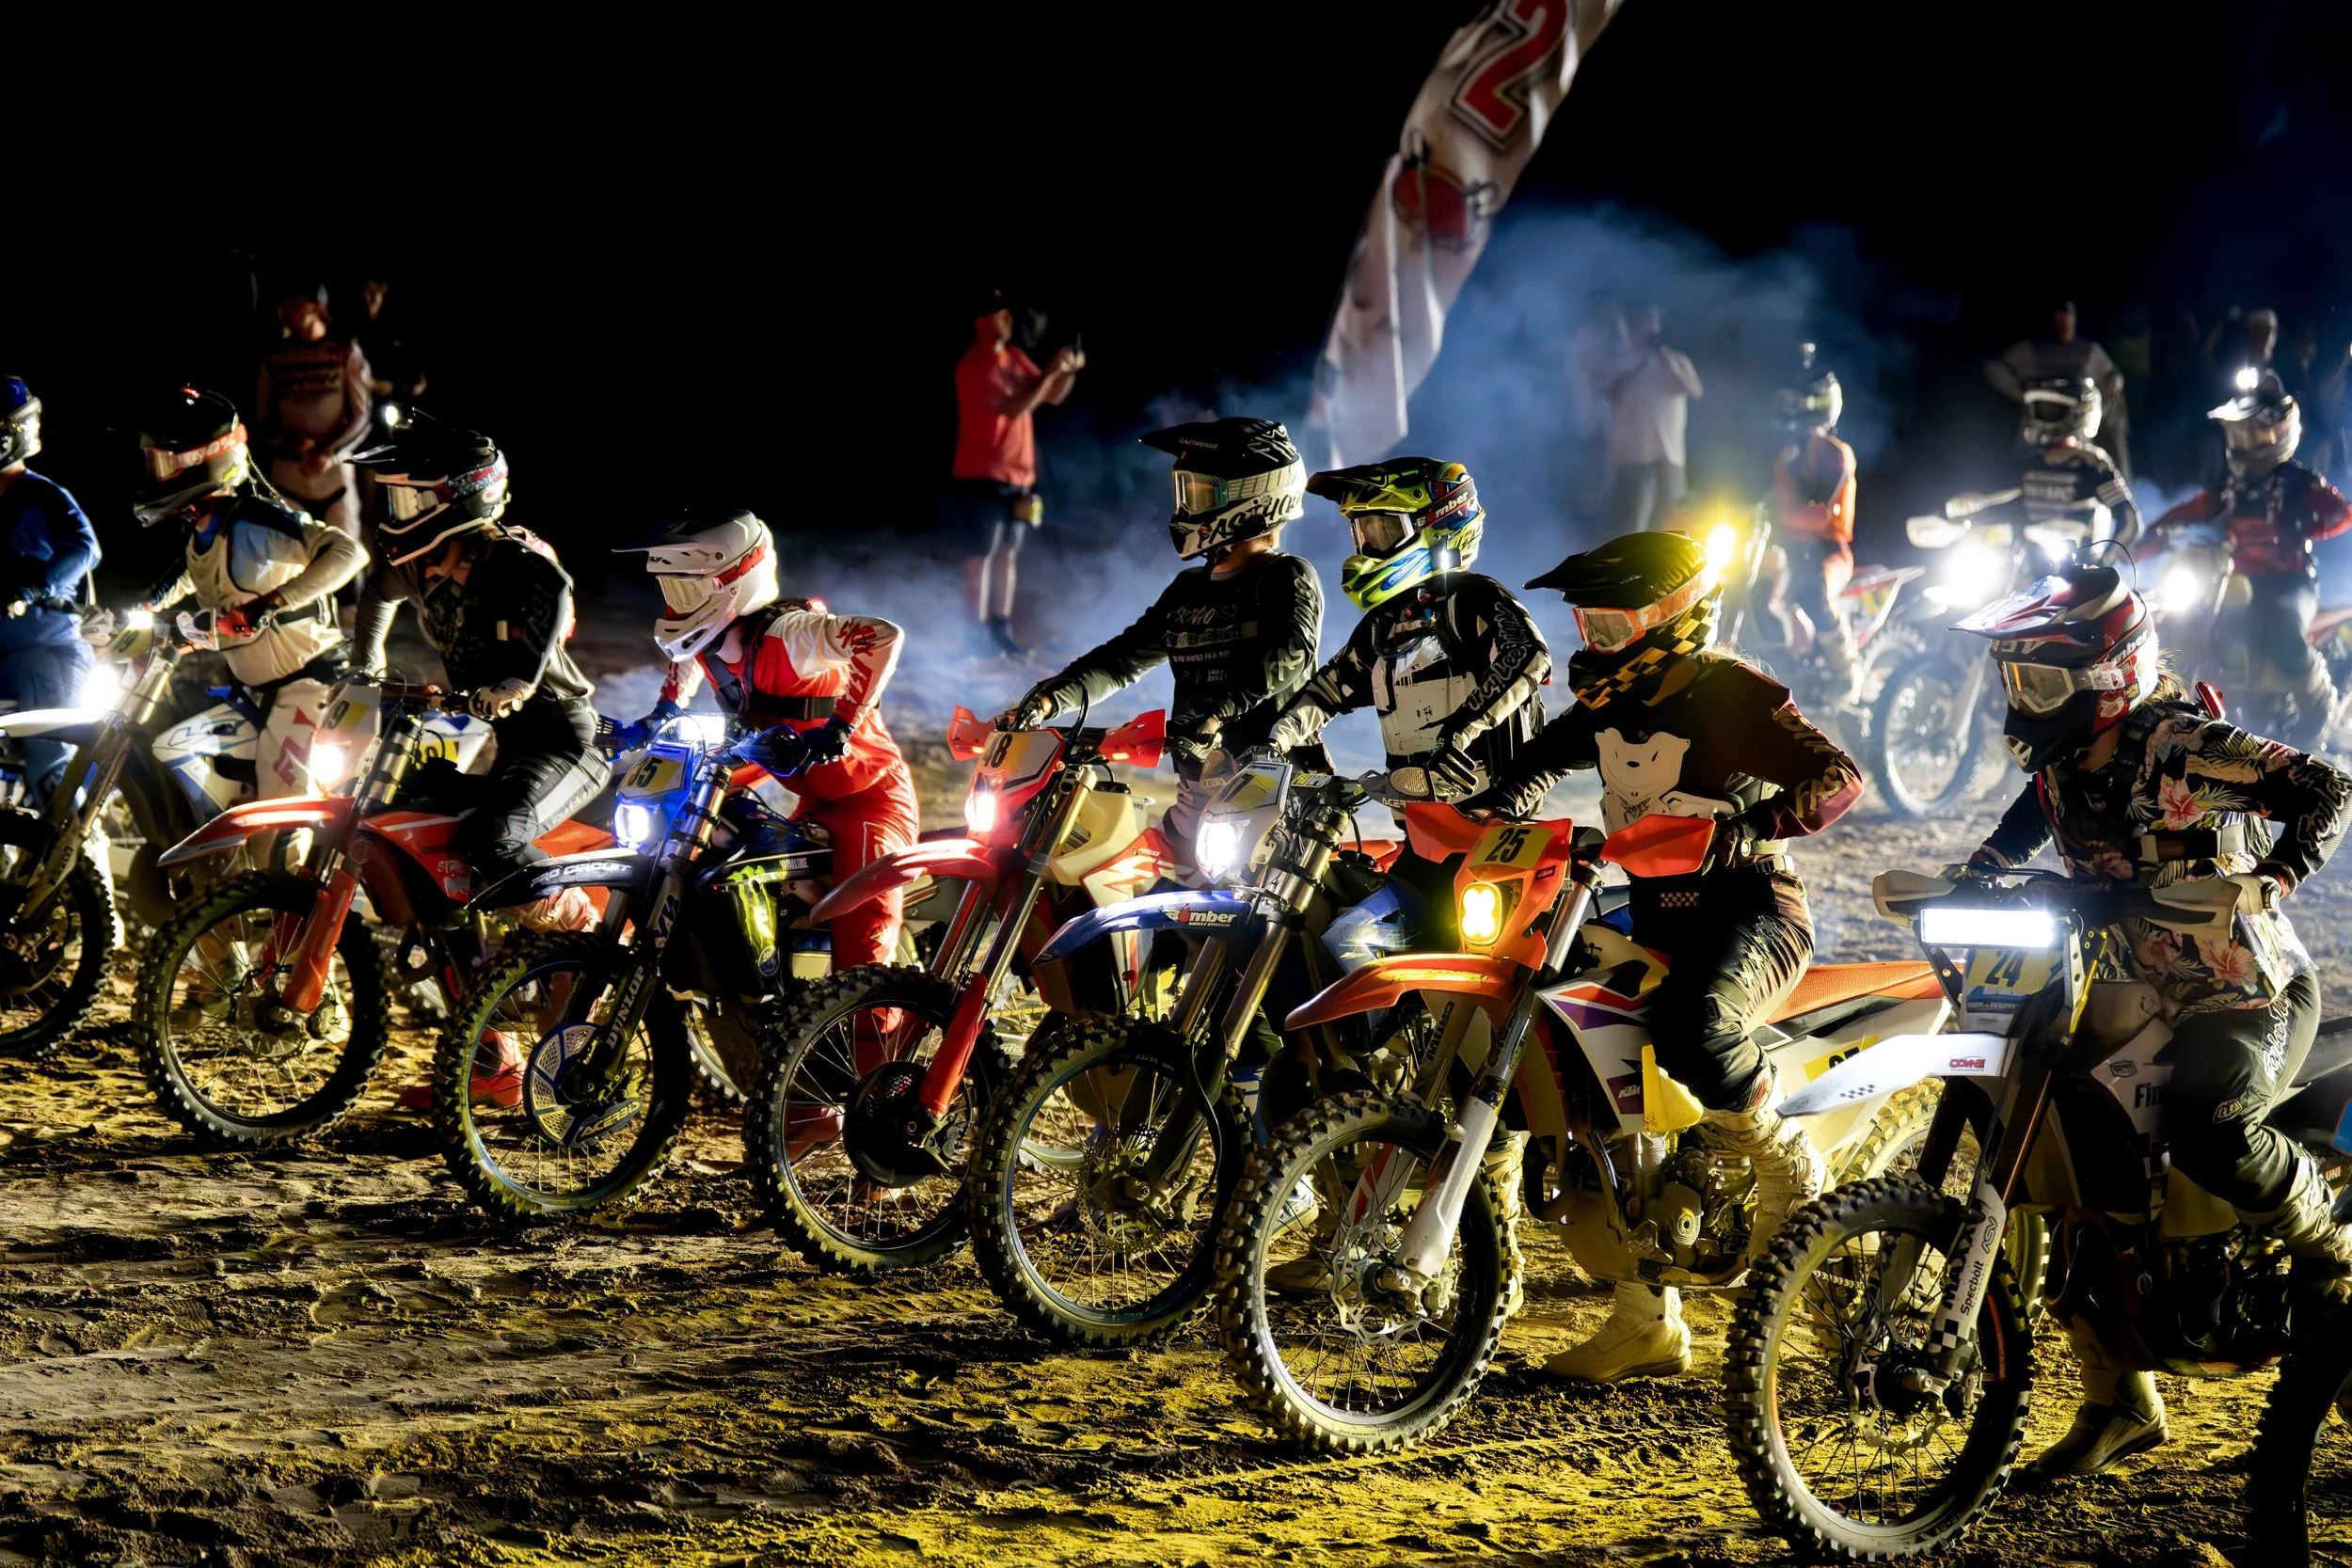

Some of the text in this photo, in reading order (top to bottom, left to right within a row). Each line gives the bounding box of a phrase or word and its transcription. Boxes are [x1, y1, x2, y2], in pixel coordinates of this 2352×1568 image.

[1485, 828, 1532, 863] 25
[564, 863, 631, 876] CIRCUIT
[1984, 949, 2028, 988] 24
[607, 965, 645, 1050] DUNLOP
[579, 1101, 641, 1138] ACERBIS
[1960, 1260, 1984, 1316] Specbolt
